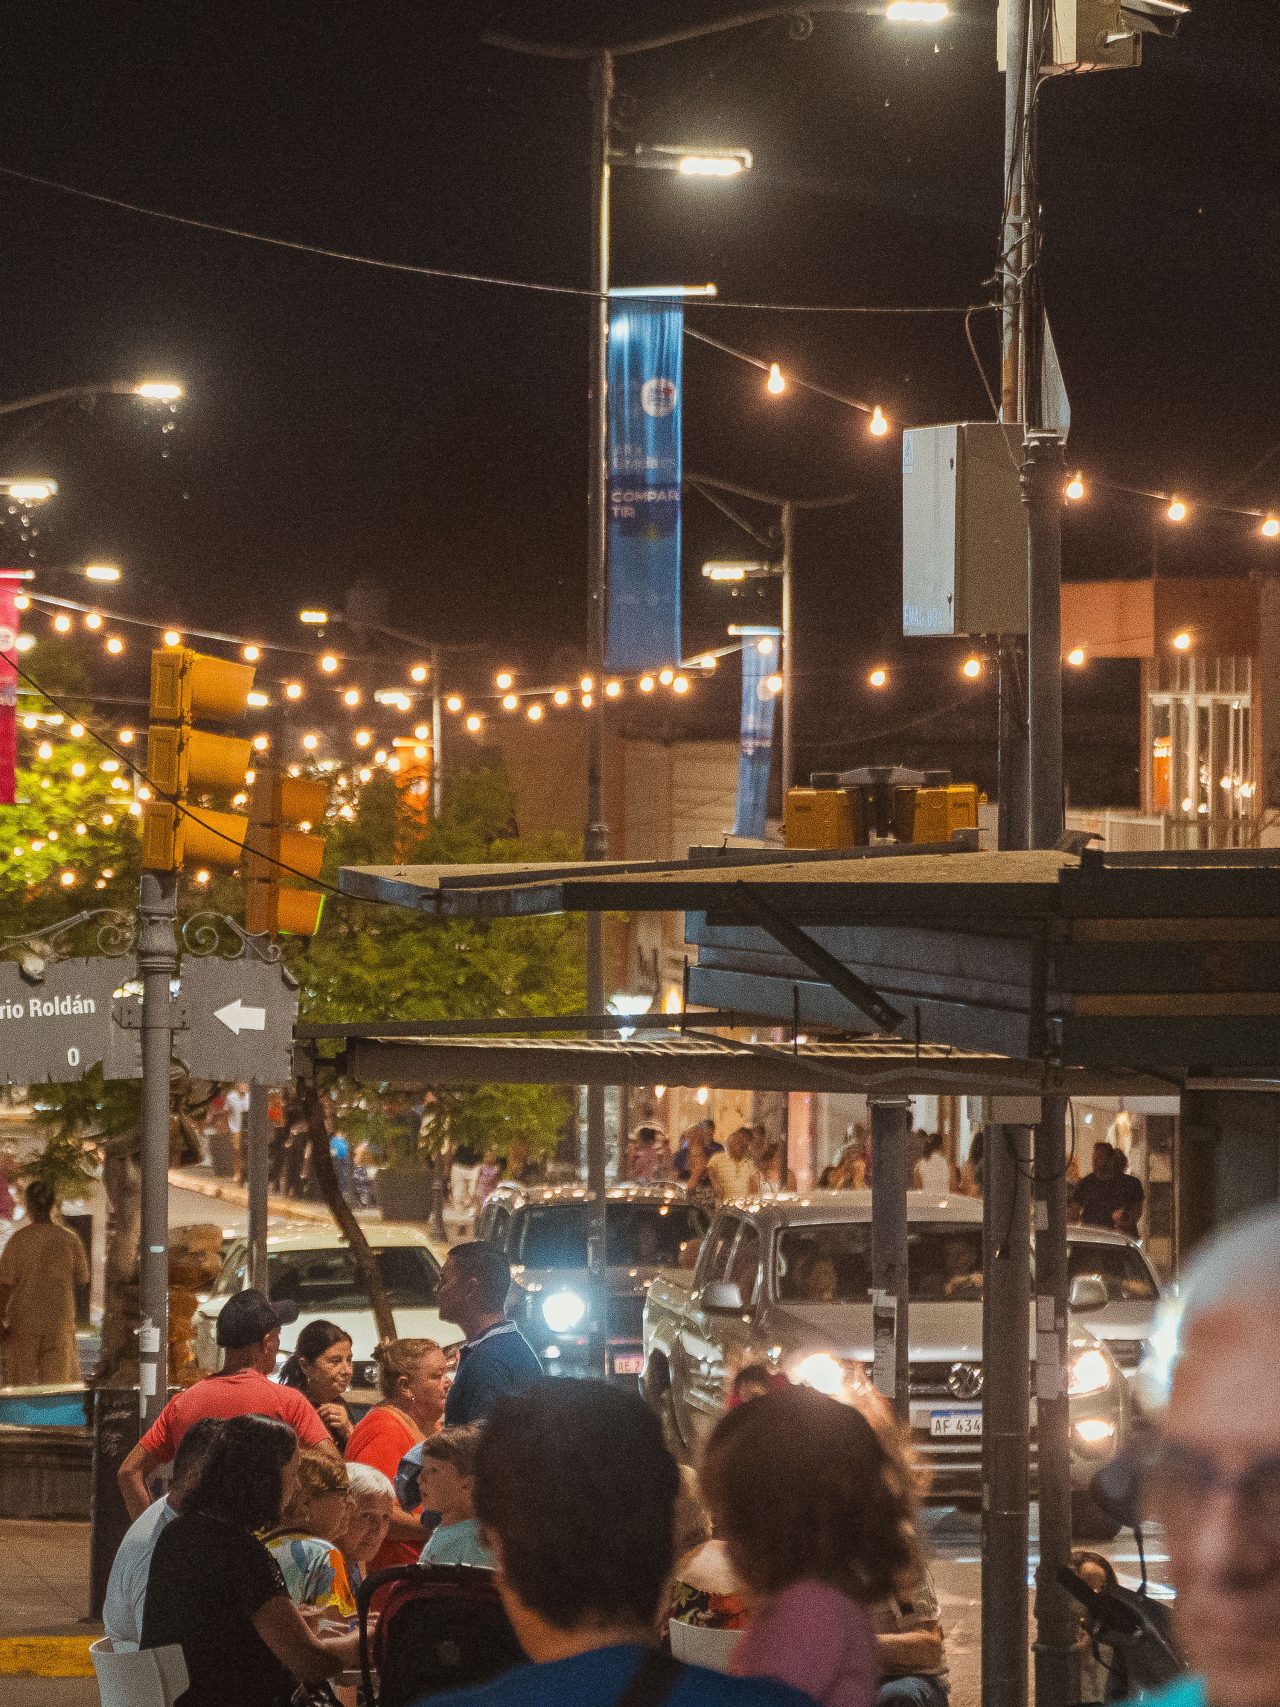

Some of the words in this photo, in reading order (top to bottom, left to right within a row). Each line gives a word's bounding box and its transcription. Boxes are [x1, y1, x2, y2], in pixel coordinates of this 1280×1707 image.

[29, 994, 95, 1018] Roldán
[67, 1047, 80, 1067] 0
[934, 1419, 950, 1434] AF
[956, 1418, 981, 1433] 434
